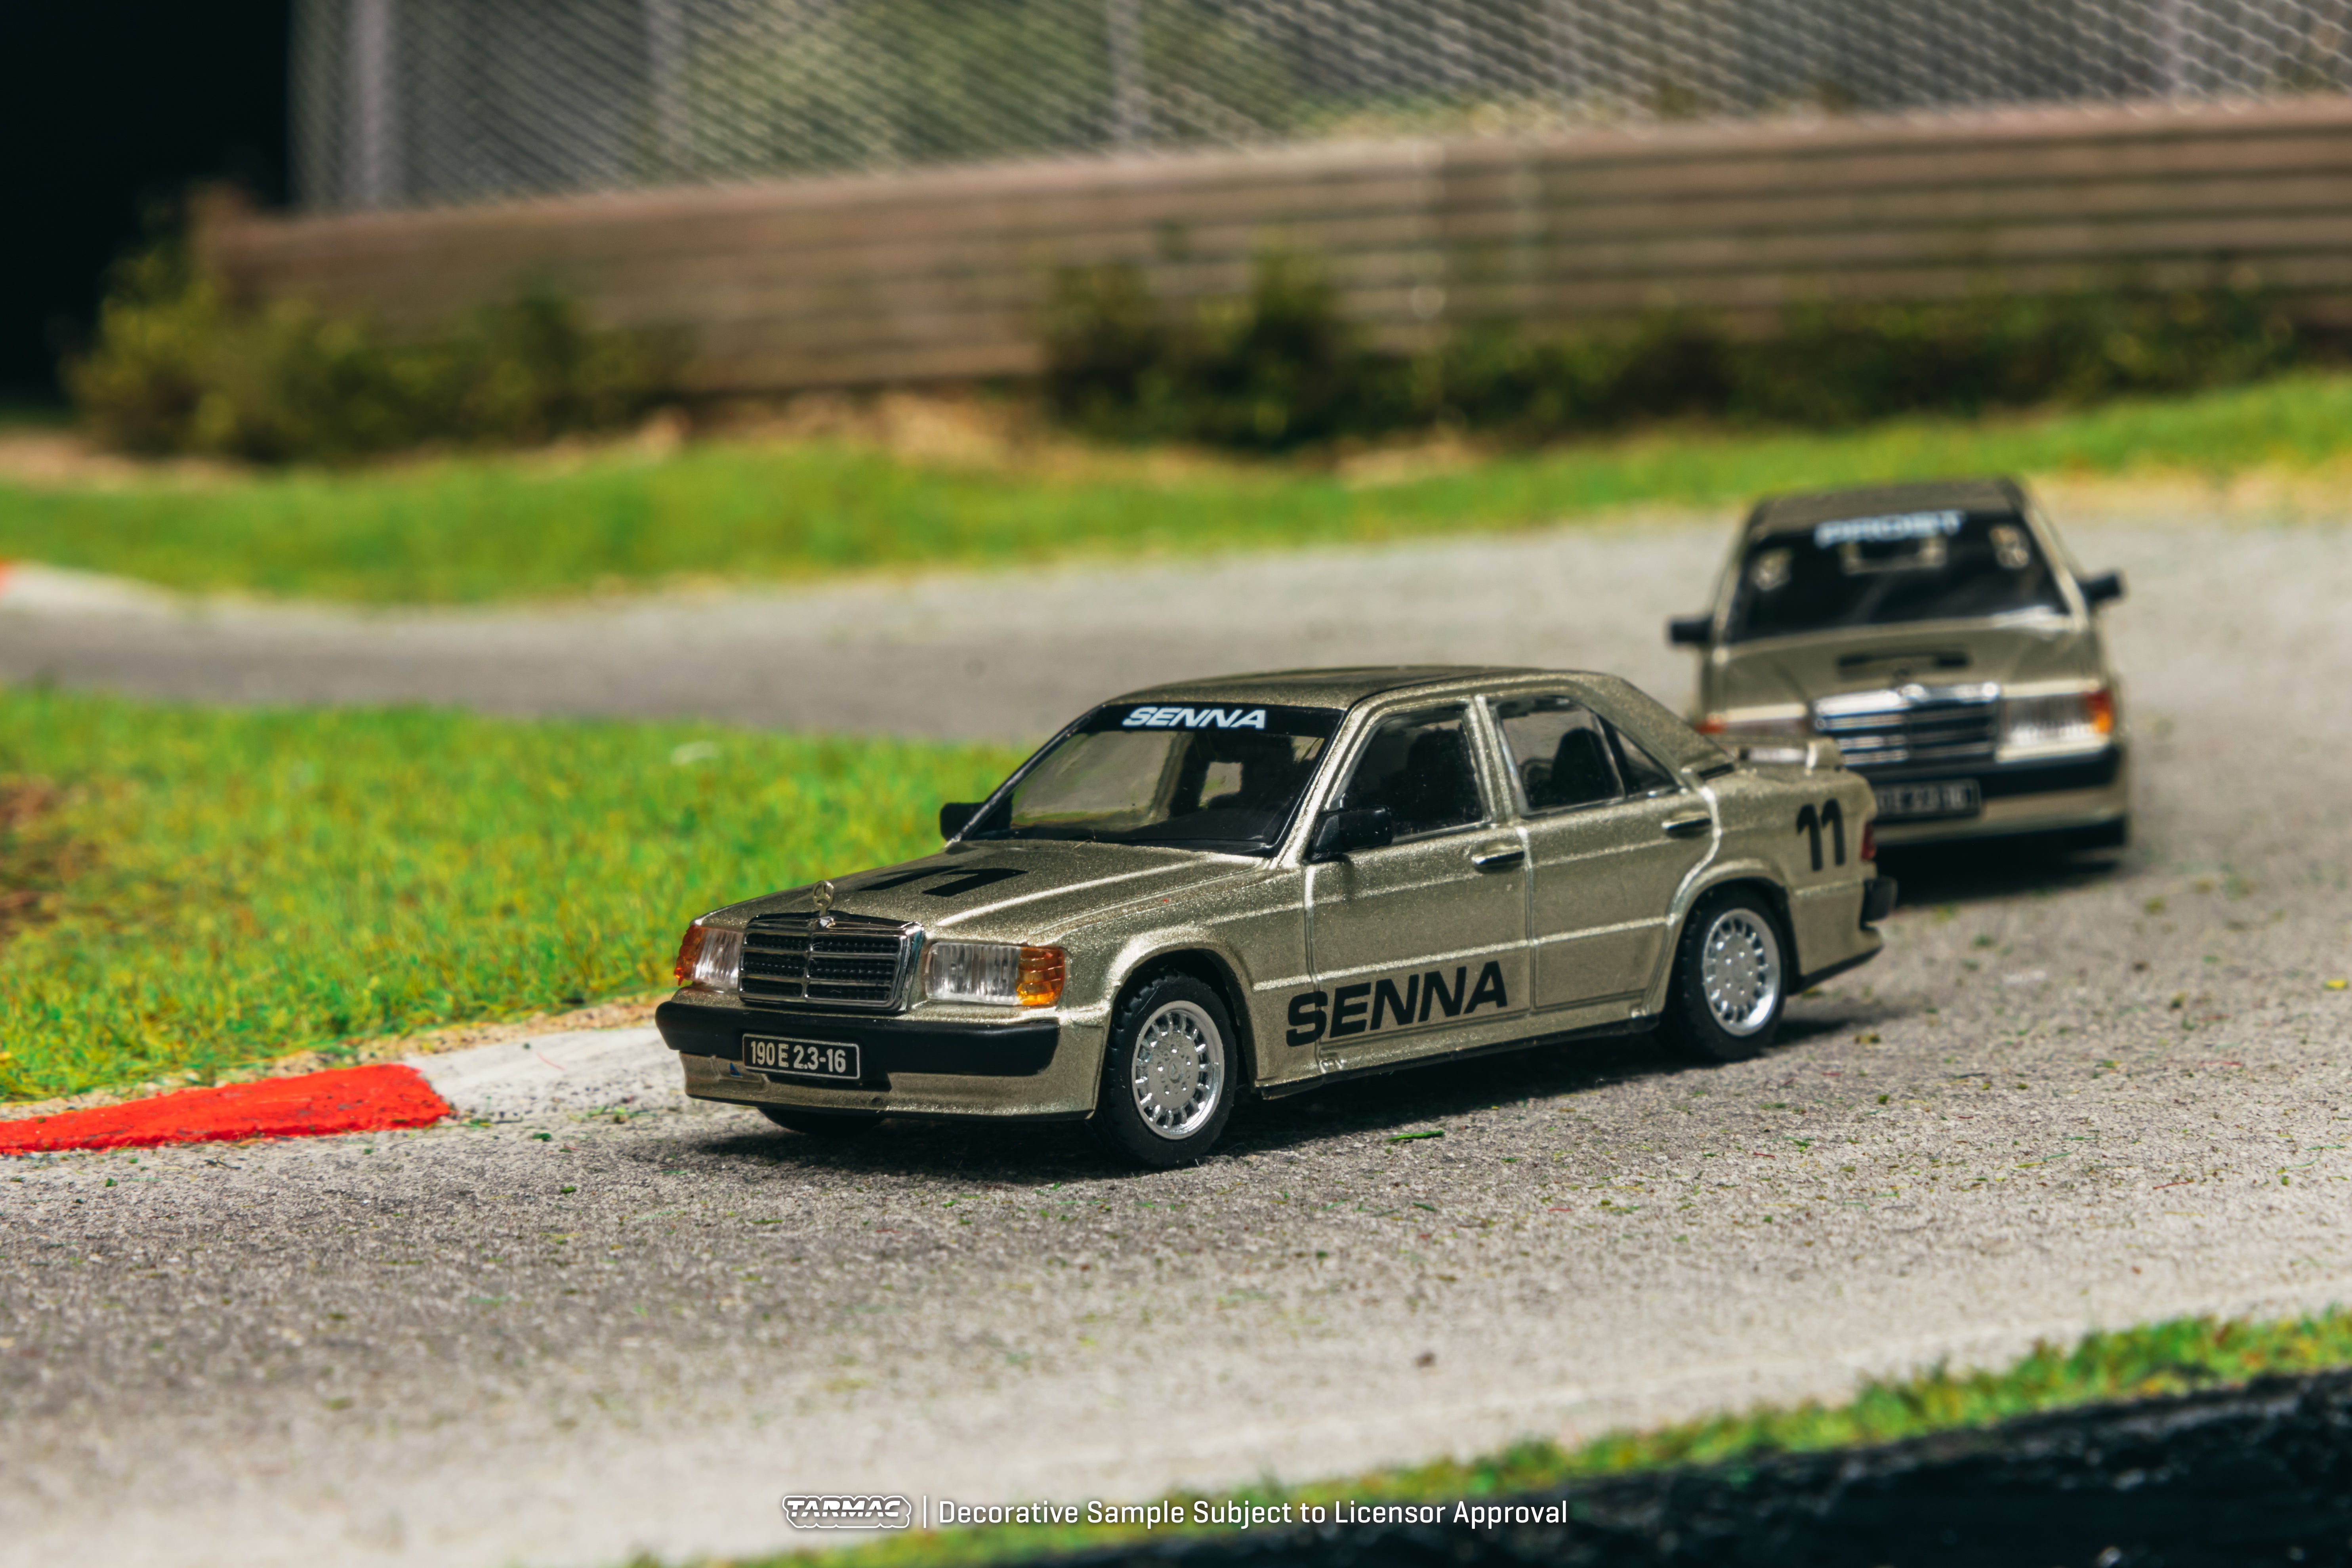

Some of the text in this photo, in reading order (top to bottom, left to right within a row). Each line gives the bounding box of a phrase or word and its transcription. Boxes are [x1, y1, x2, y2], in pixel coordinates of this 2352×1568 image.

[1122, 706, 1266, 730] SENNA
[1795, 798, 1846, 872] 11
[1286, 960, 1508, 1047] SENNA
[793, 1045, 846, 1073] 2.3-16
